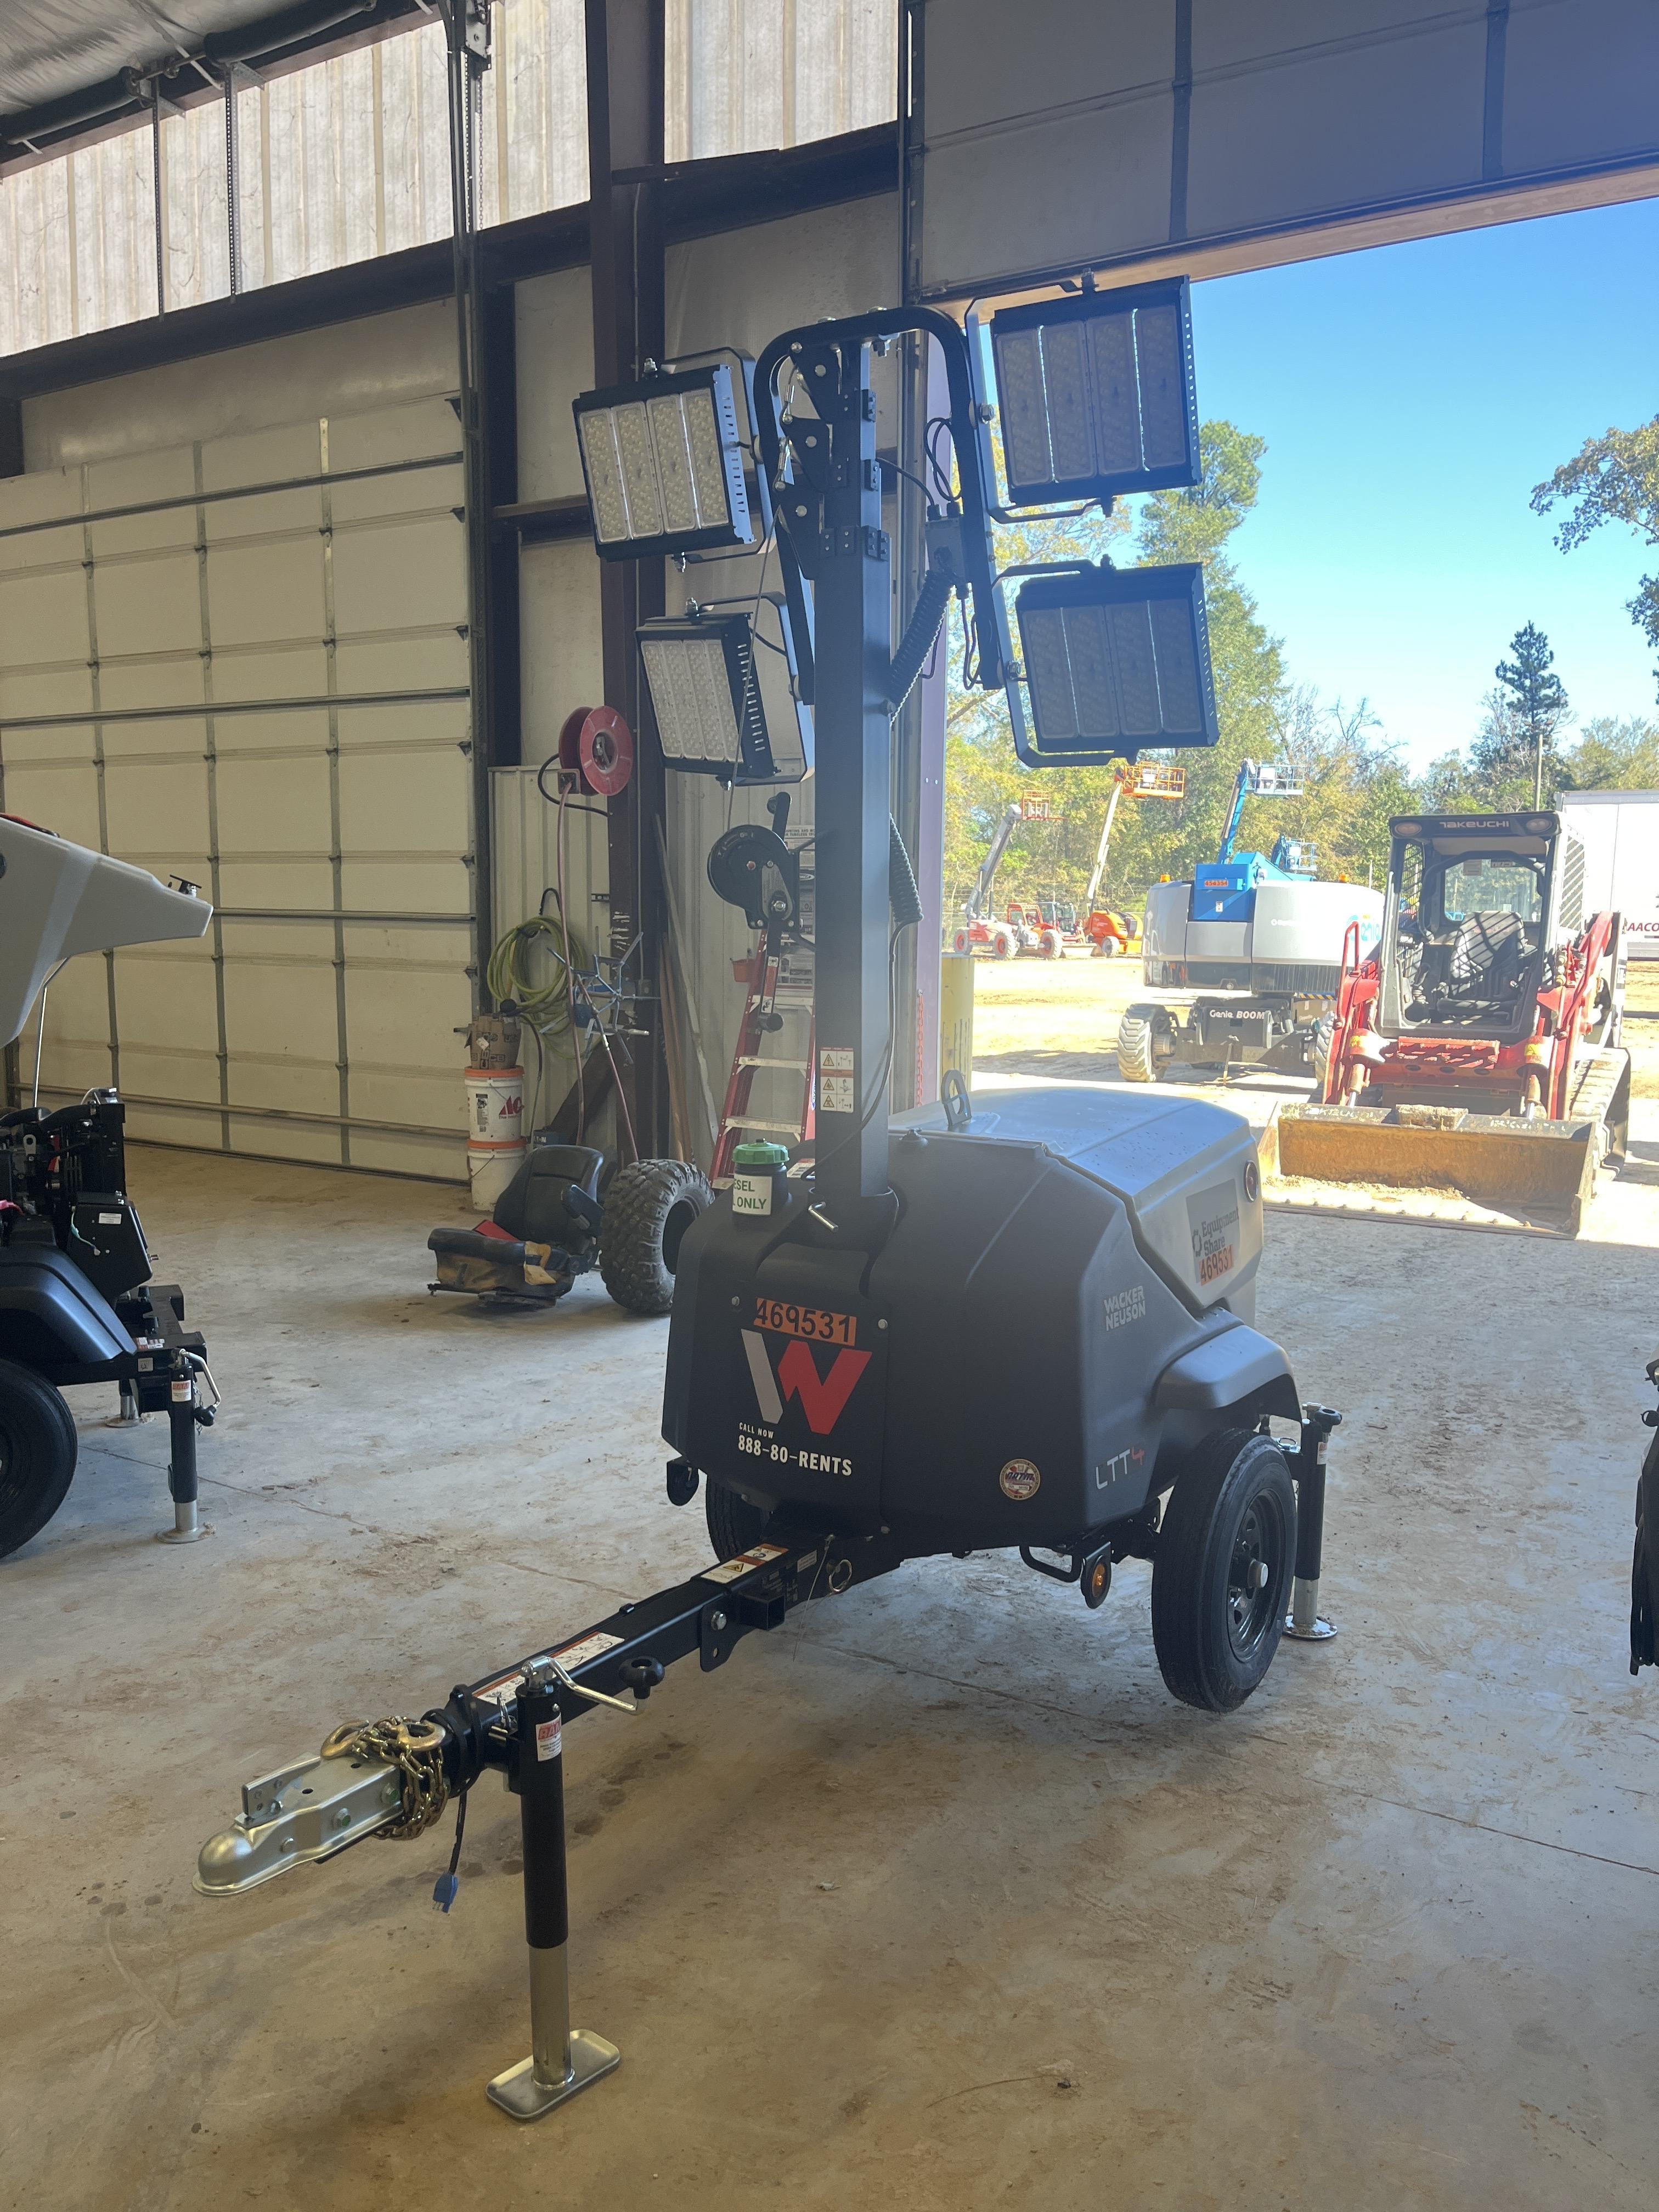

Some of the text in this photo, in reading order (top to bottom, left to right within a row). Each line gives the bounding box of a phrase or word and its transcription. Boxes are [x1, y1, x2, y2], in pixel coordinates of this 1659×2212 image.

[1209, 1009, 1234, 1018] Genie
[737, 1197, 767, 1210] ONLY
[1201, 1206, 1239, 1238] Equipment
[1204, 1236, 1225, 1256] Share
[1200, 1244, 1233, 1282] 469531
[1104, 1285, 1146, 1314] WACKER
[755, 1299, 851, 1343] 469531
[1105, 1300, 1146, 1331] NEUSON
[738, 1422, 774, 1438] CALL NOW
[738, 1434, 853, 1476] 888-80-RENTS
[1095, 1446, 1145, 1489] LTT4
